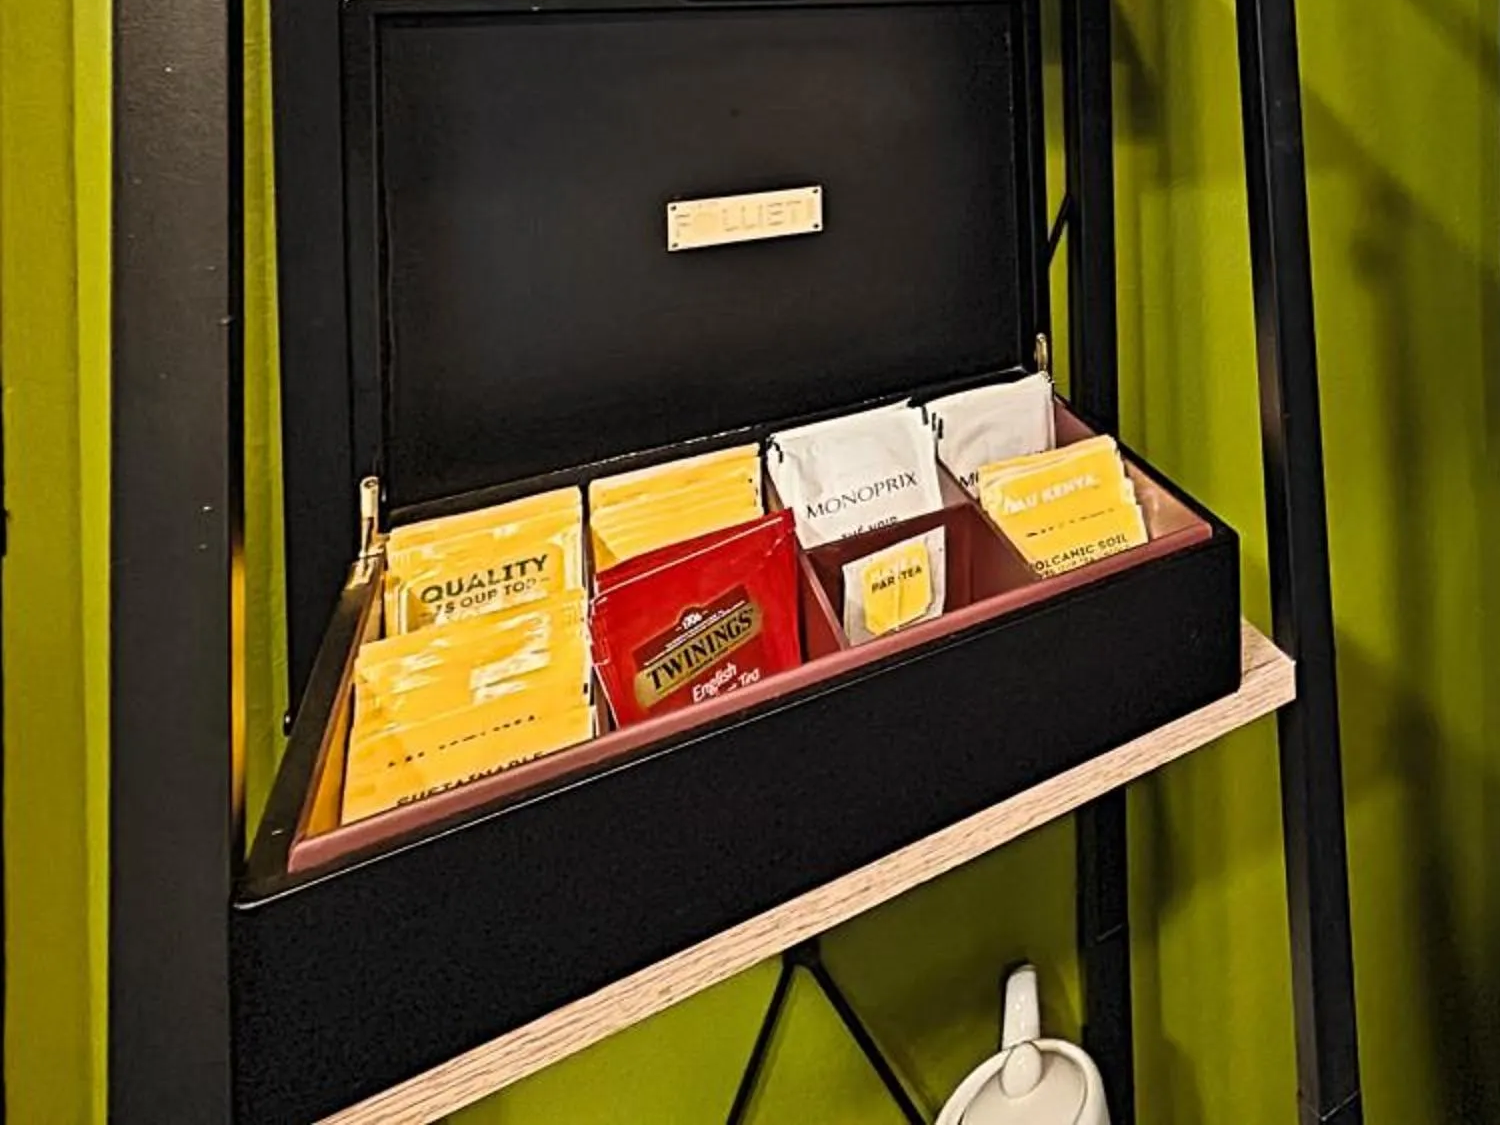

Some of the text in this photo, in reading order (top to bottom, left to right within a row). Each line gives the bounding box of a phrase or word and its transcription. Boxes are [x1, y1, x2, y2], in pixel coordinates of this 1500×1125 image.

[805, 471, 919, 519] MONOPRIX
[1031, 544, 1095, 572] OLCANIC
[1098, 533, 1129, 549] SOIL
[420, 553, 549, 604] QUALITY
[647, 608, 754, 690] TWININGS
